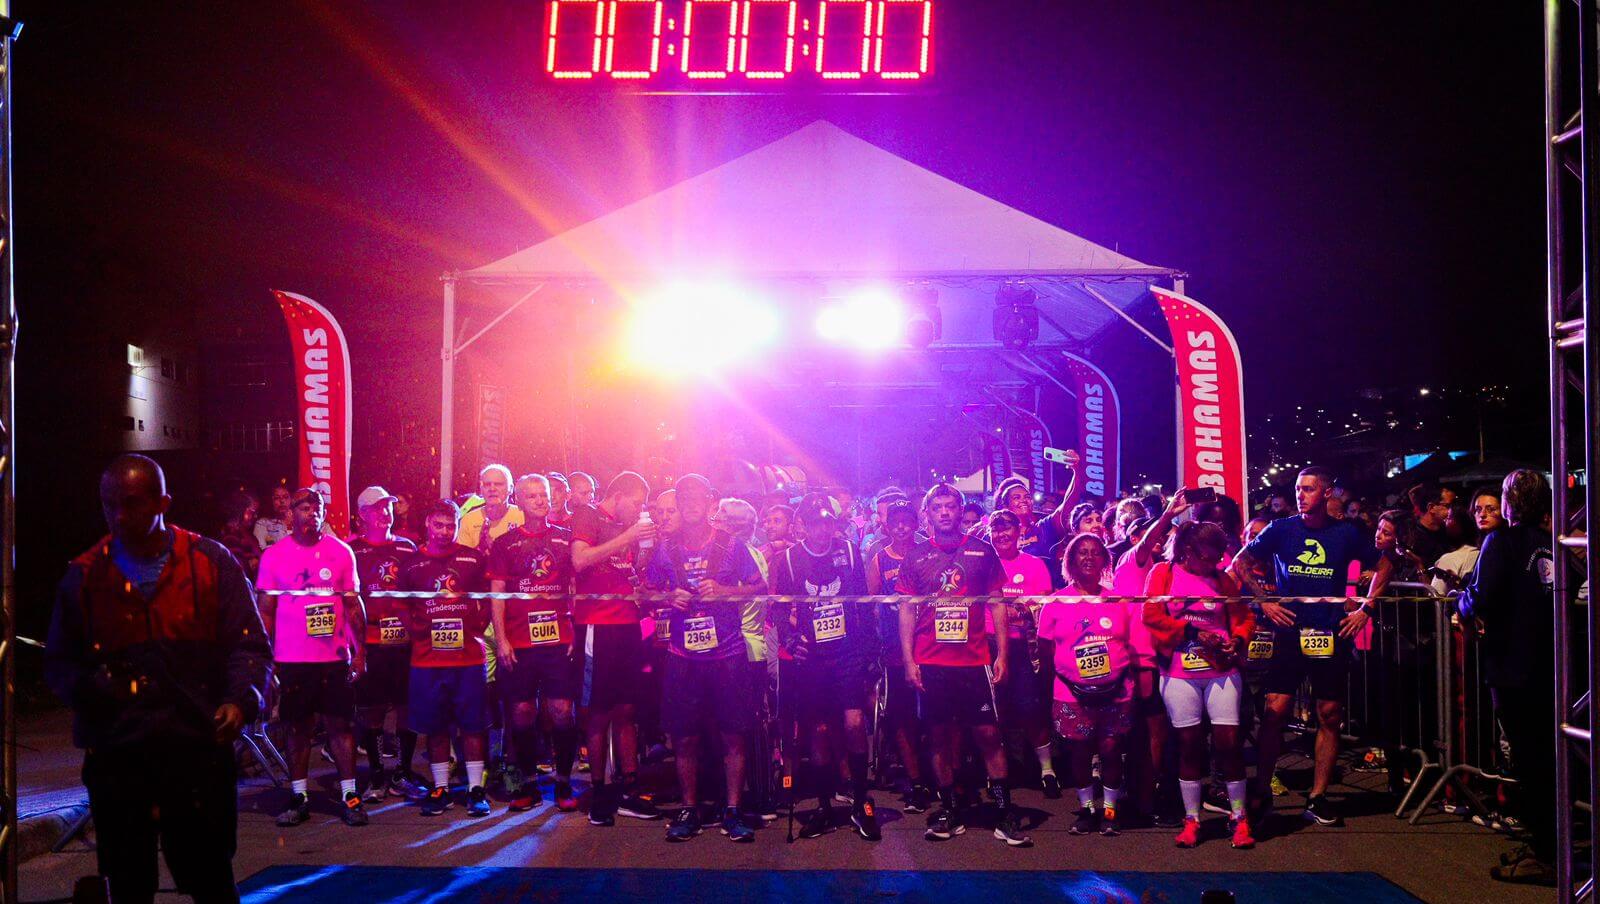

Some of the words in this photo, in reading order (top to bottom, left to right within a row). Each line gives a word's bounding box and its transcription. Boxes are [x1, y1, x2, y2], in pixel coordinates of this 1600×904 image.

[547, 0, 931, 79] 00:00:00
[1187, 330, 1226, 495] BAHAMAS
[1085, 383, 1105, 497] BAHAMAS
[1287, 565, 1334, 576] CALDEIRA
[309, 615, 334, 628] 2368
[816, 618, 841, 632] 2332
[938, 621, 964, 632] 2344
[434, 631, 459, 642] 2342
[531, 625, 557, 638] GUIA
[687, 630, 712, 644] 2364
[1304, 637, 1329, 649] 2328
[1080, 656, 1105, 670] 2359
